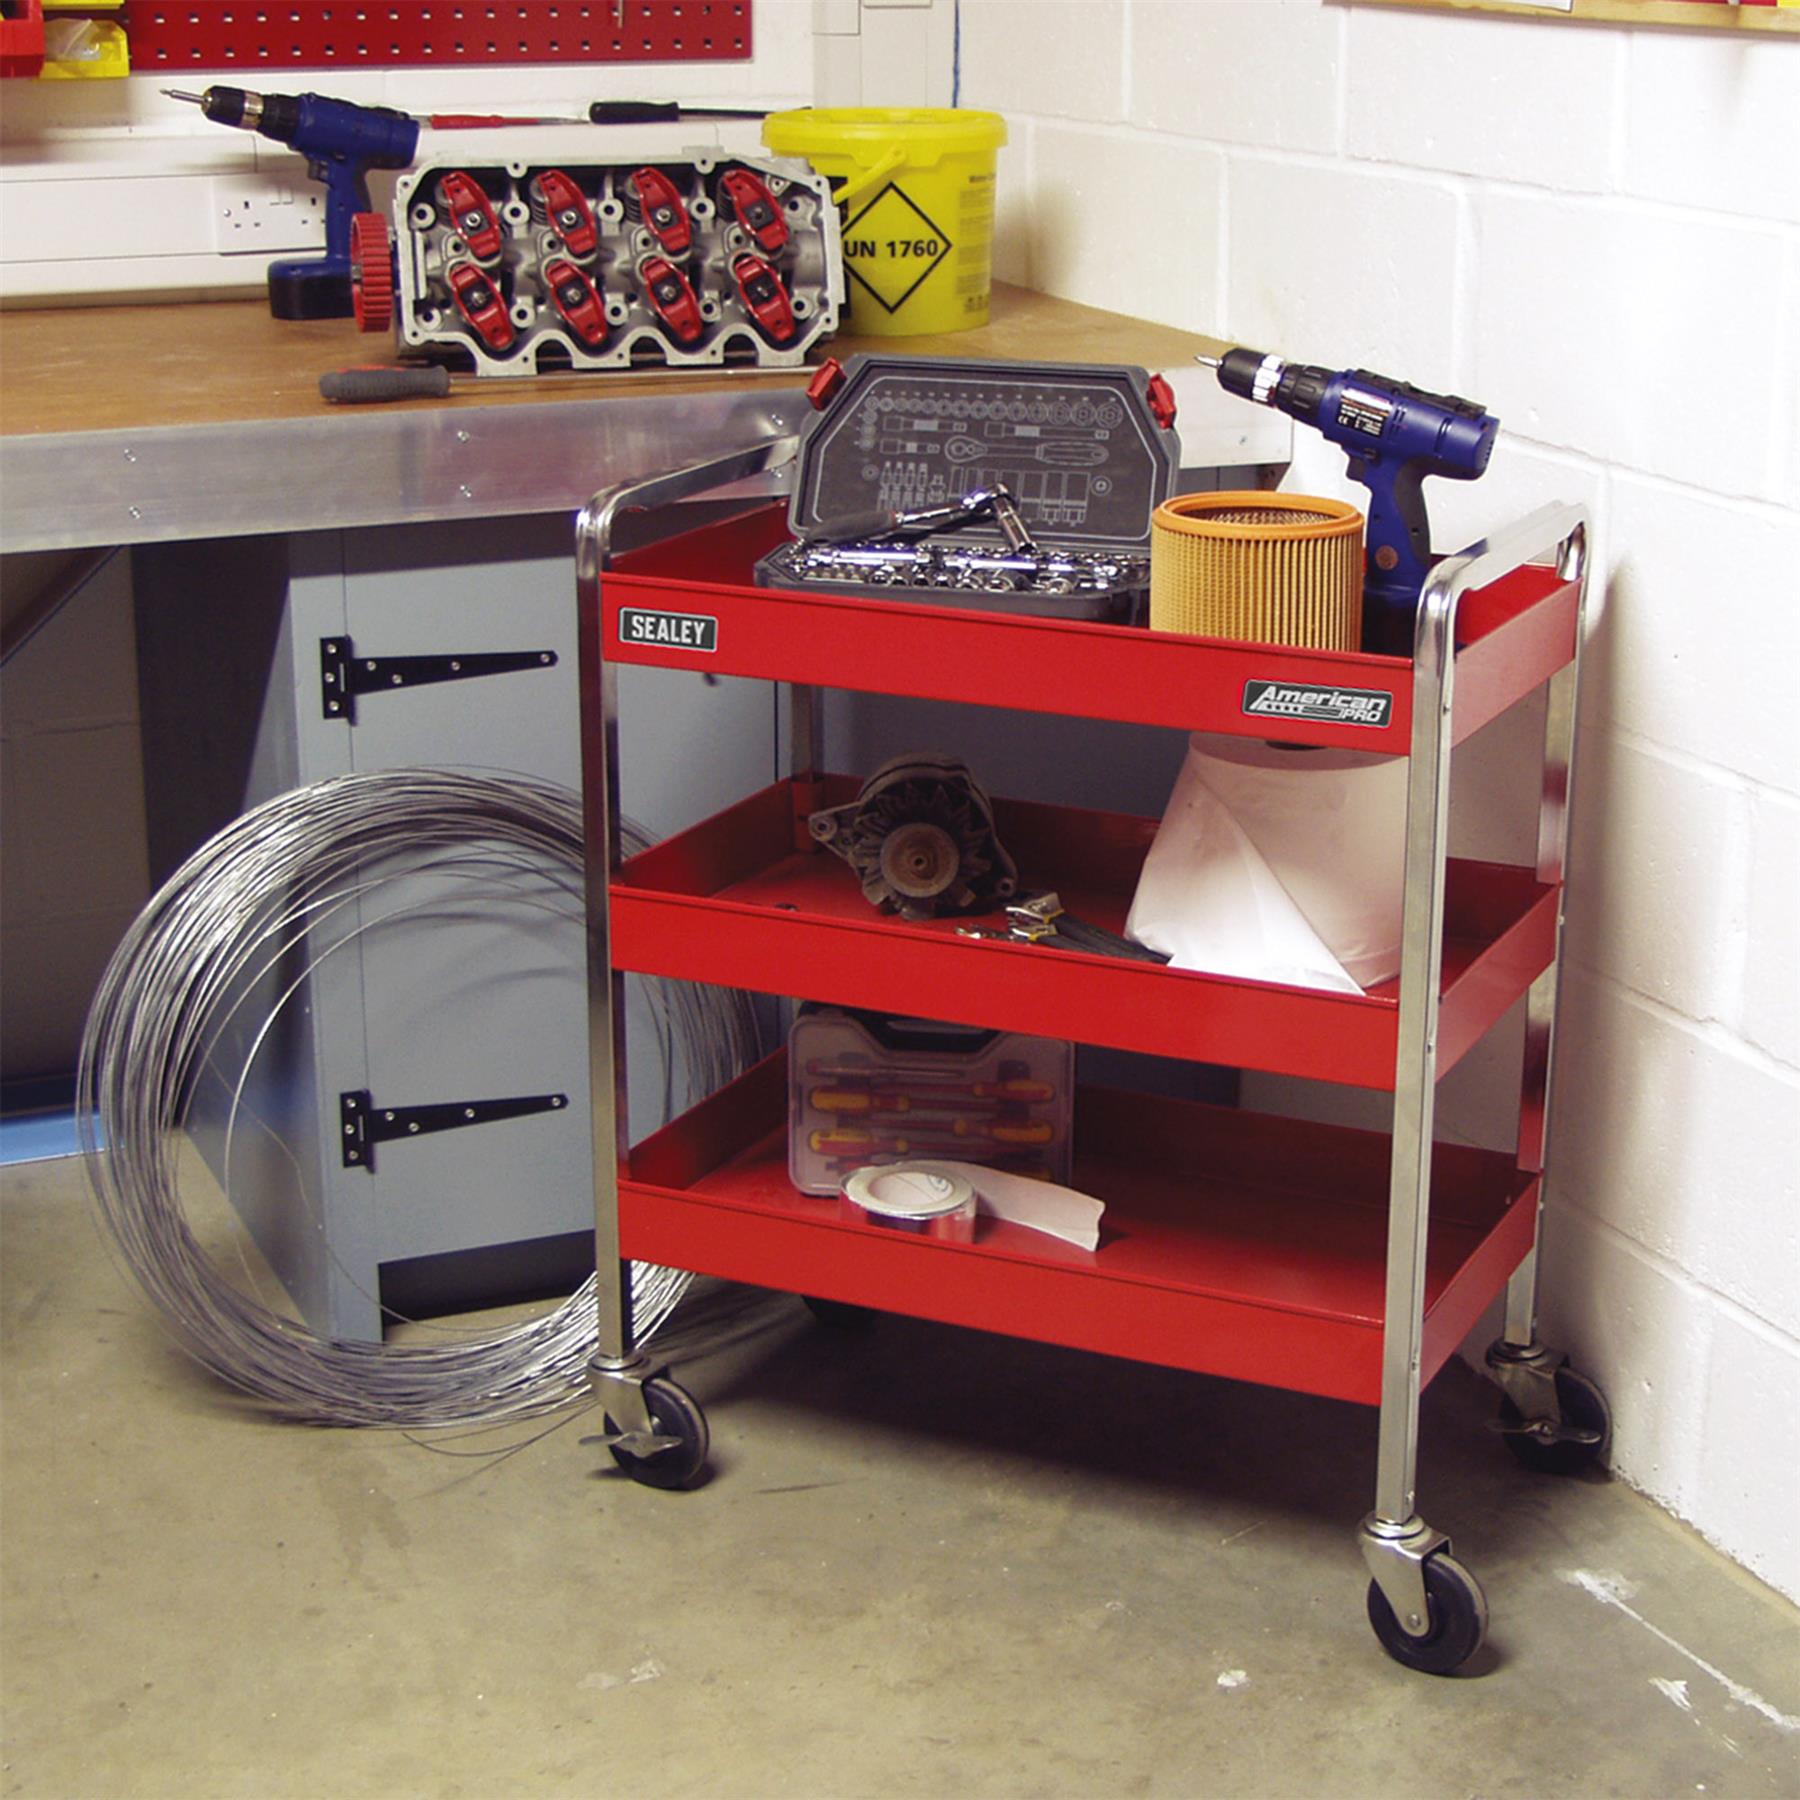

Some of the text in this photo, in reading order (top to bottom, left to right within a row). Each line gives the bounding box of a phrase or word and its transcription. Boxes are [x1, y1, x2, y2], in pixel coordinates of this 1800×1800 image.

[843, 240, 876, 258] UN
[886, 239, 938, 258] 1760
[631, 615, 706, 645] SEALEY
[1249, 685, 1388, 711] American
[1342, 708, 1382, 722] PRO
